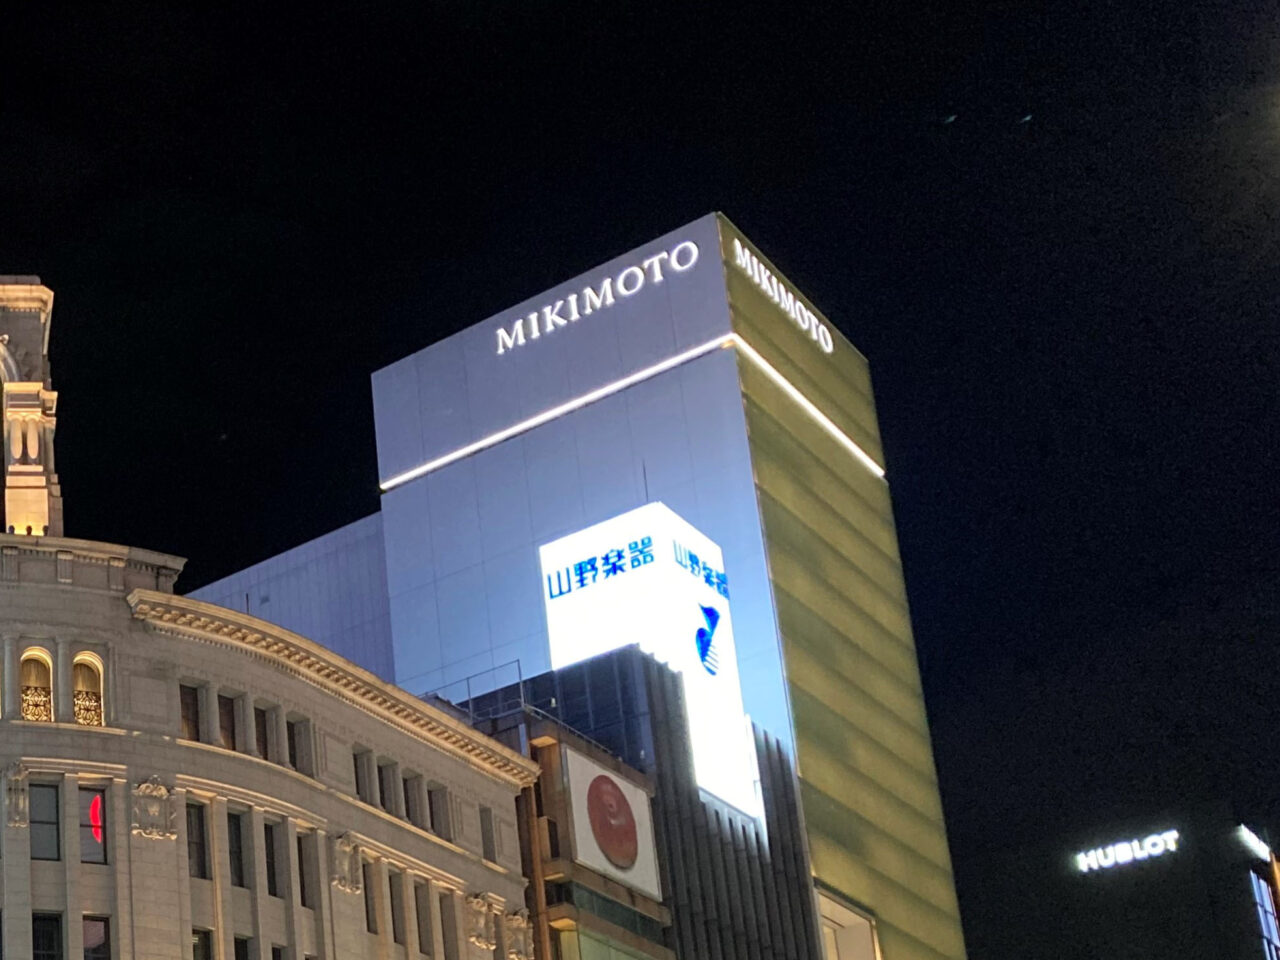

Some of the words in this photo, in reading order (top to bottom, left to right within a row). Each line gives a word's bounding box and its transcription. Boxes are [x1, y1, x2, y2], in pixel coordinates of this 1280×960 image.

[495, 239, 700, 354] MIKIMOTO
[733, 238, 834, 354] MIKIMOTO
[546, 536, 655, 600] 山野楽器
[1076, 828, 1180, 873] HUBLOT
